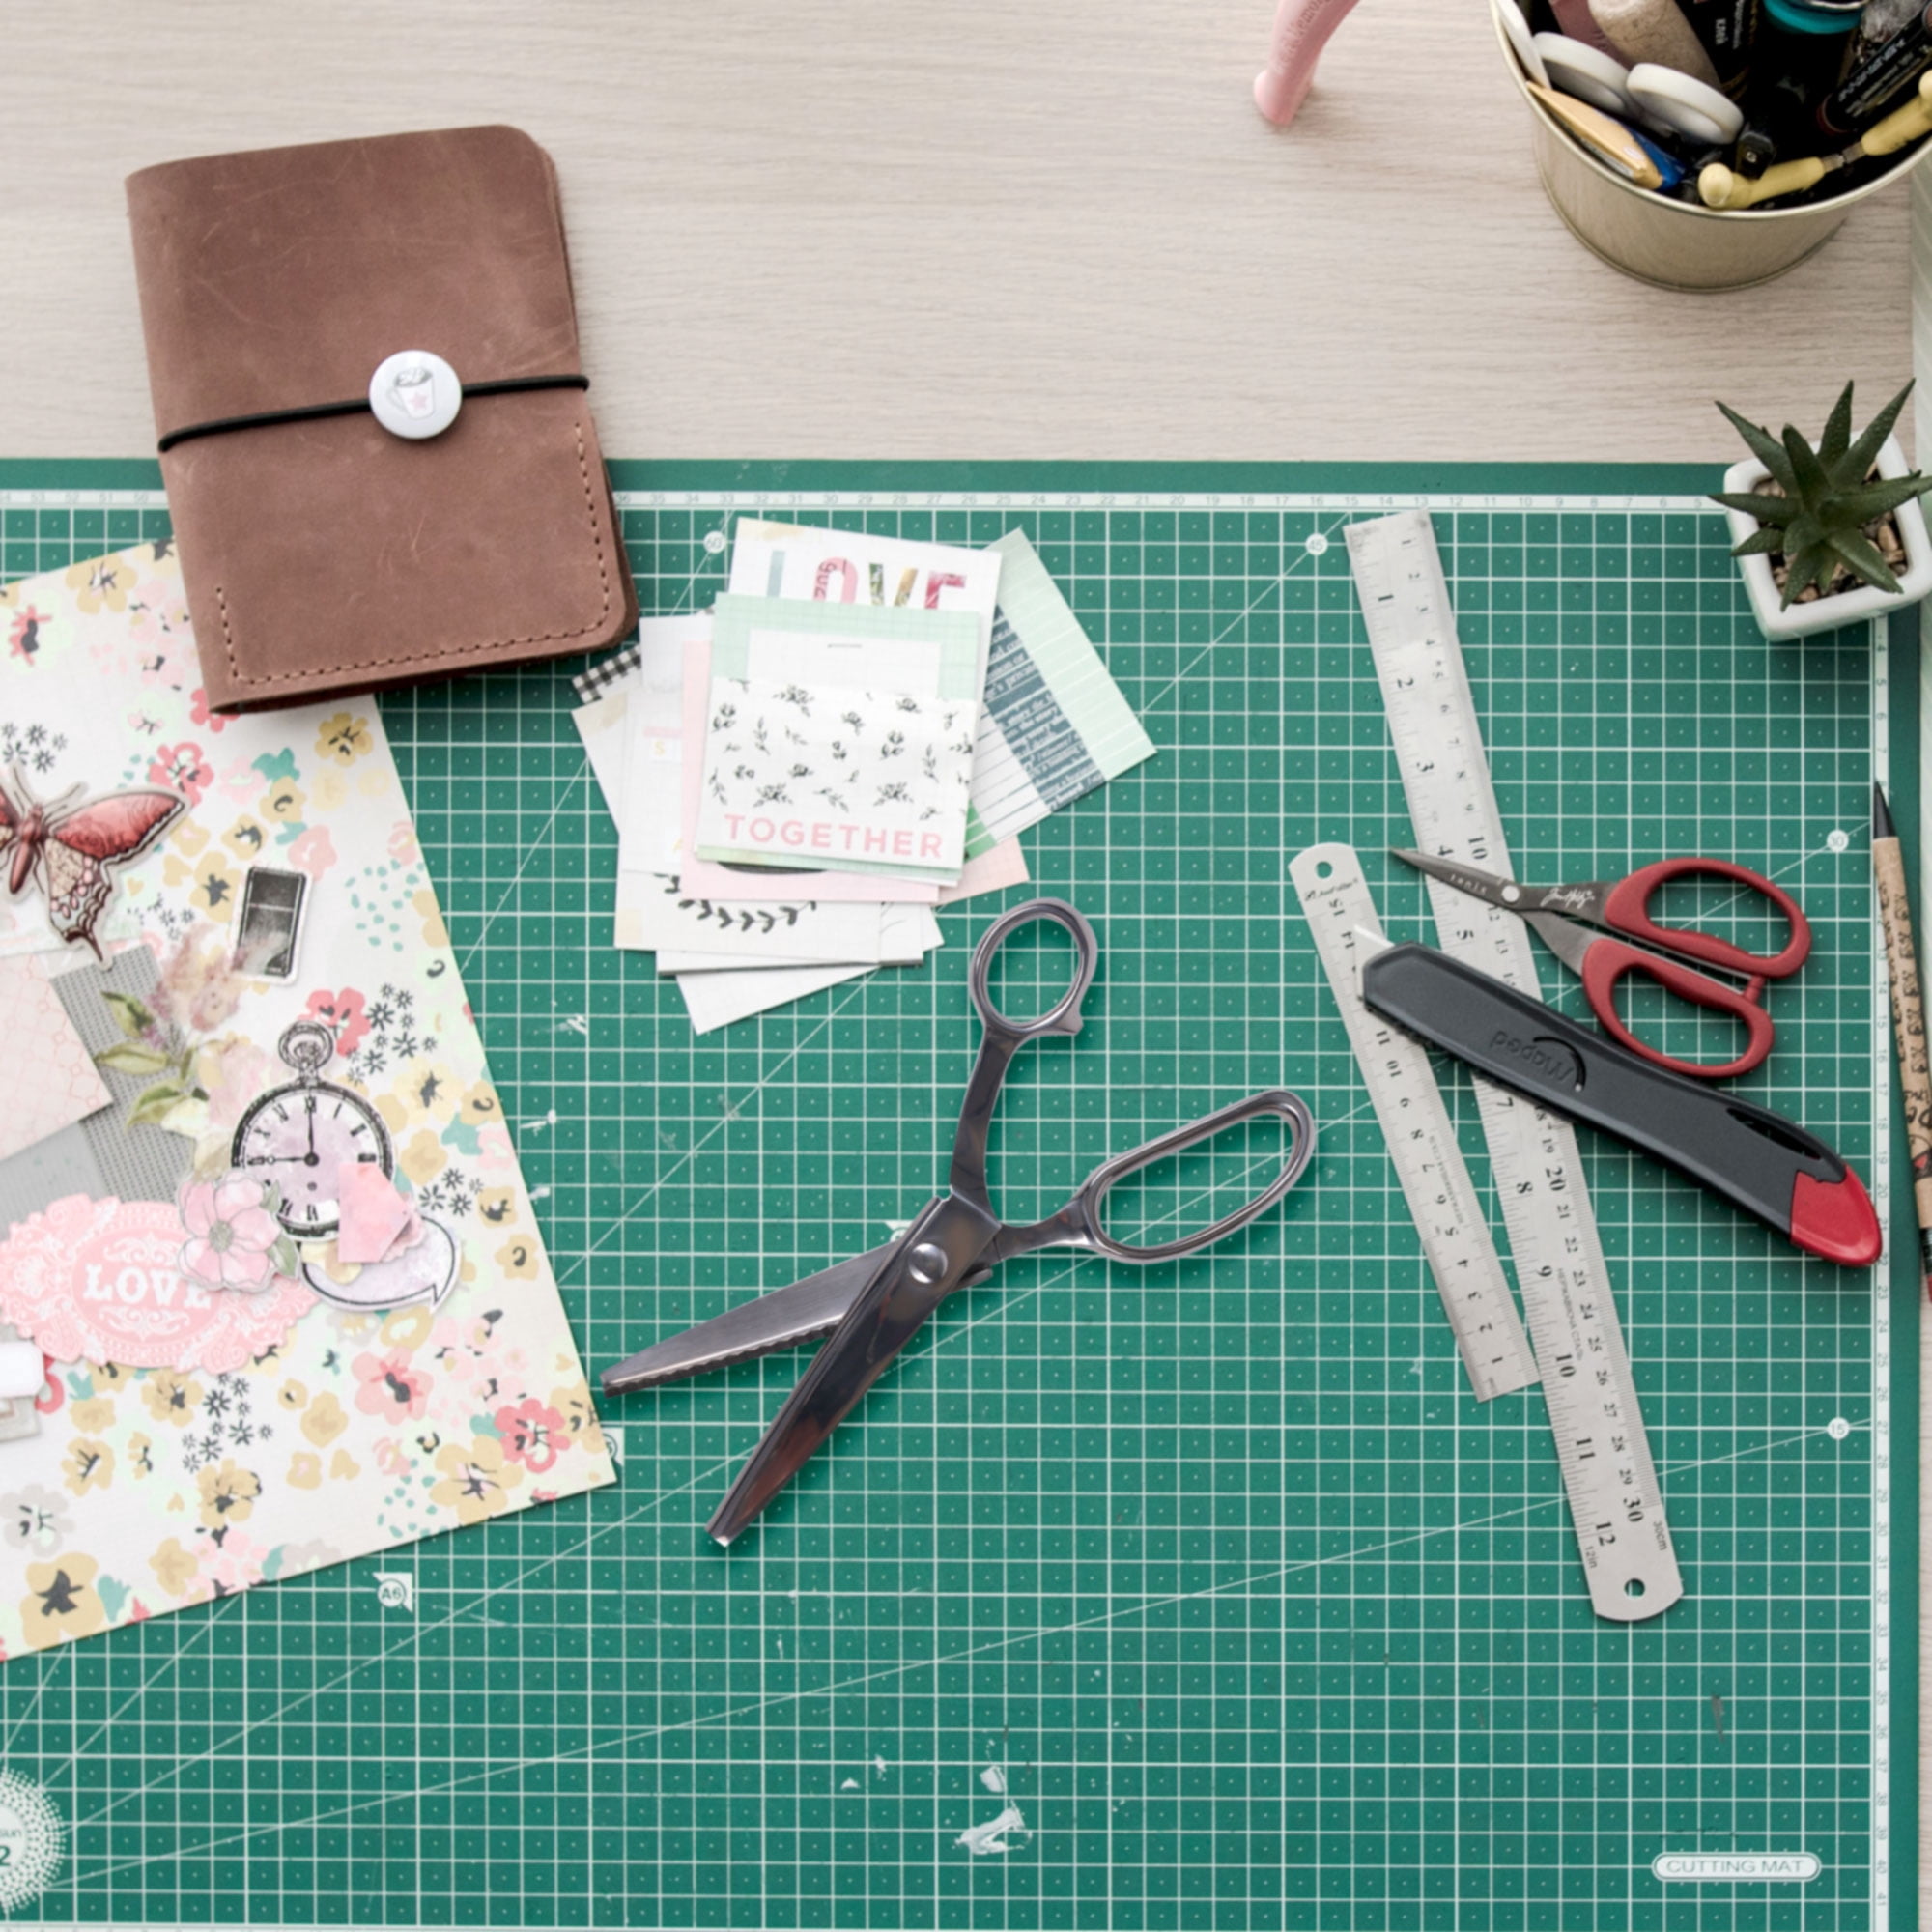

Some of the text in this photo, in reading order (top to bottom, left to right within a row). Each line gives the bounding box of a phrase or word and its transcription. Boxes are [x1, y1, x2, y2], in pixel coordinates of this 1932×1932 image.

[650, 494, 665, 504] 35
[685, 494, 699, 504] 34
[720, 494, 734, 504] 33
[754, 494, 769, 504] 32
[788, 494, 803, 504] 31
[823, 494, 838, 504] 30
[858, 494, 872, 504] 29
[893, 494, 907, 504] 28
[927, 494, 942, 504] 27
[961, 494, 976, 504] 26
[997, 494, 1011, 504] 25
[1031, 494, 1045, 504] 24
[1065, 494, 1080, 504] 23
[1100, 494, 1115, 504] 22
[1135, 494, 1150, 504] 21
[1170, 494, 1184, 504] 20
[1205, 494, 1219, 504] 19
[1240, 494, 1255, 504] 18
[1274, 494, 1289, 504] 17
[1309, 494, 1323, 504] 16
[1344, 496, 1358, 506] 15
[1379, 496, 1394, 506] 14
[1448, 496, 1463, 506] 12
[1483, 496, 1497, 506] 11
[1518, 496, 1532, 506] 10
[1555, 497, 1564, 507] 9
[1590, 497, 1599, 507] 8
[1625, 497, 1634, 507] 7
[1660, 497, 1668, 507] 6
[1693, 497, 1702, 507] 5
[724, 813, 944, 860] TOGETHER
[1468, 837, 1488, 860] 10
[1877, 982, 1888, 995] 14
[1877, 1016, 1888, 1028] 15
[1490, 1030, 1574, 1082] Maped
[1877, 1050, 1888, 1063] 16
[1877, 1084, 1888, 1095] 17
[1877, 1118, 1888, 1130] 18
[1376, 1030, 1391, 1045] 11
[1386, 1060, 1403, 1078] 10
[1410, 1128, 1425, 1140] 8
[1422, 1163, 1435, 1173] 7
[1457, 1259, 1469, 1268] 4
[1542, 1138, 1555, 1153] 19
[1877, 1151, 1888, 1164] 19
[1546, 1165, 1567, 1191] 20
[1877, 1185, 1888, 1198] 20
[1557, 1204, 1571, 1219] 21
[1877, 1219, 1888, 1231] 21
[1565, 1236, 1578, 1253] 22
[1877, 1253, 1888, 1265] 22
[1573, 1270, 1586, 1287] 23
[83, 1264, 212, 1310] LOVE
[1877, 1287, 1888, 1299] 23
[1580, 1304, 1594, 1320] 24
[1497, 1097, 1514, 1107] 7
[1517, 1181, 1533, 1194] 8
[1536, 1265, 1552, 1277] 9
[1556, 1353, 1576, 1378] 10
[1577, 1437, 1596, 1461] 11
[1596, 1520, 1617, 1546] 12
[1877, 1321, 1888, 1333] 24
[1588, 1337, 1602, 1352] 25
[1877, 1354, 1888, 1367] 25
[1596, 1370, 1609, 1385] 26
[1877, 1387, 1888, 1401] 26
[1604, 1403, 1617, 1418] 27
[1832, 1424, 1845, 1435] 15
[1877, 1422, 1888, 1434] 27
[1611, 1436, 1625, 1453] 28
[1877, 1456, 1888, 1468] 28
[1619, 1469, 1633, 1485] 29
[1877, 1490, 1888, 1502] 29
[1623, 1496, 1644, 1522] 30
[1653, 1520, 1668, 1551] 30cm
[1877, 1523, 1888, 1536] 30
[1585, 1546, 1598, 1569] 12in
[1877, 1557, 1888, 1569] 31
[381, 1587, 402, 1600] A6
[1877, 1591, 1888, 1604] 32
[1877, 1625, 1888, 1637] 33
[1877, 1659, 1888, 1670] 34
[1877, 1691, 1888, 1705] 35
[1877, 1725, 1888, 1739] 36
[1877, 1759, 1888, 1773] 37
[1877, 1793, 1888, 1806] 38
[1877, 1827, 1888, 1840] 39
[0, 1845, 11, 1866] 2
[1666, 1860, 1804, 1874] CUTTING MAT
[1877, 1860, 1888, 1874] 40
[1877, 1893, 1888, 1906] 41
